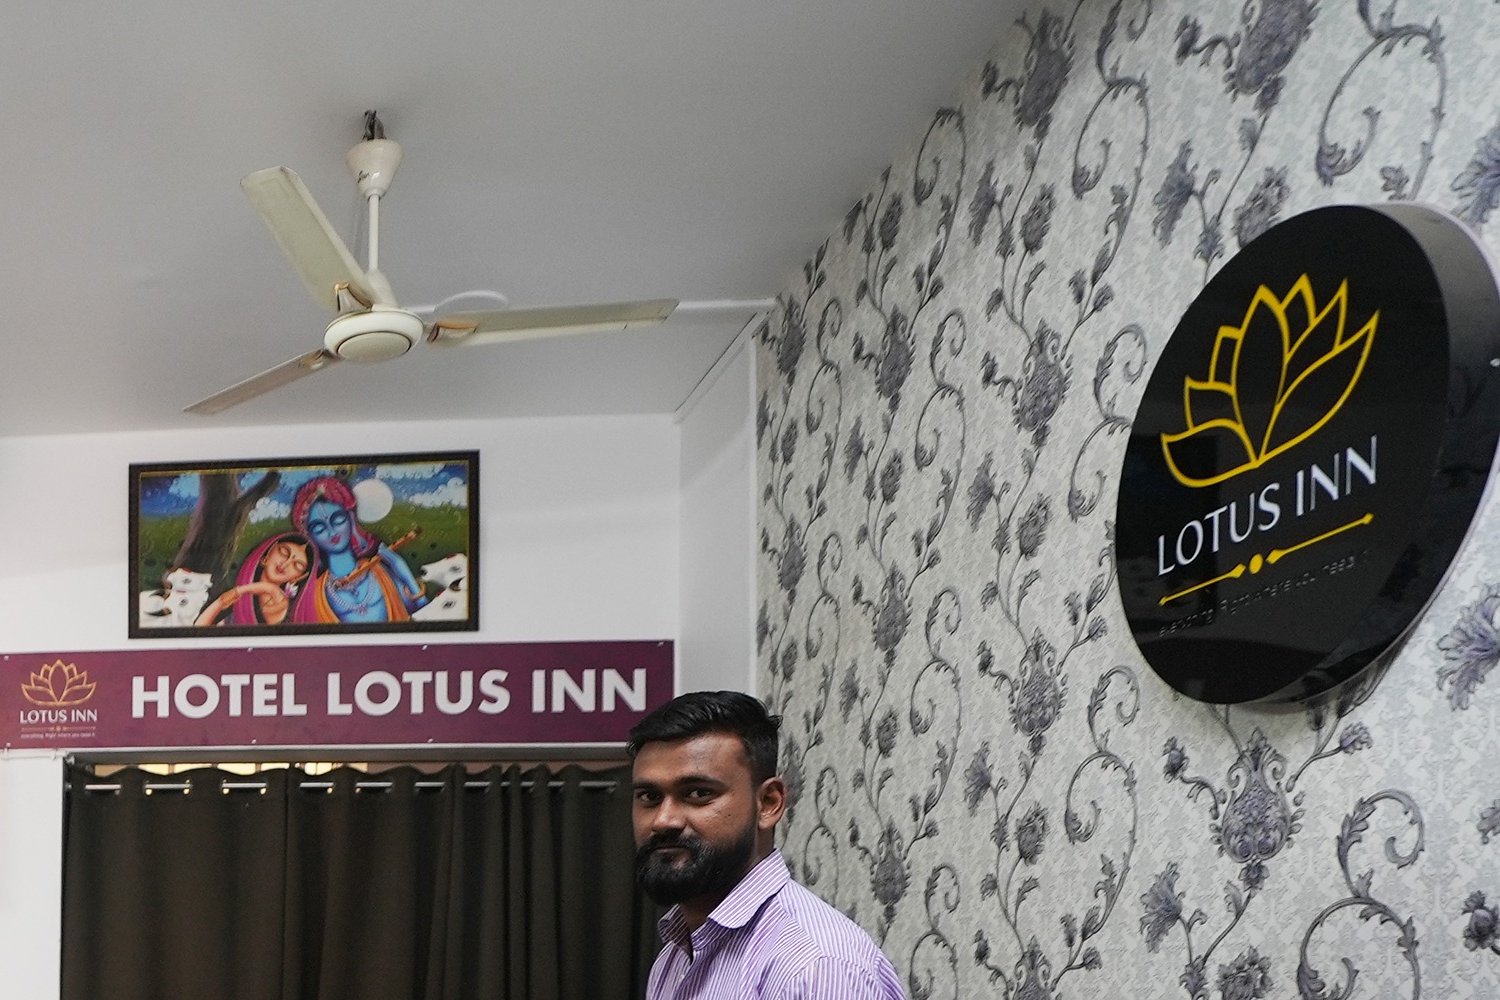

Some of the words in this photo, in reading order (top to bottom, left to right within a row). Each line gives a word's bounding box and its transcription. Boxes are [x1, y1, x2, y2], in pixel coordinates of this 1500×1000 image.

[1157, 482, 1281, 577] LOTUS
[1295, 434, 1378, 517] INN
[20, 709, 68, 724] LOTUS
[71, 708, 98, 723] INN
[131, 673, 308, 719] HOTEL
[327, 669, 511, 716] LOTUS
[531, 667, 648, 713] INN
